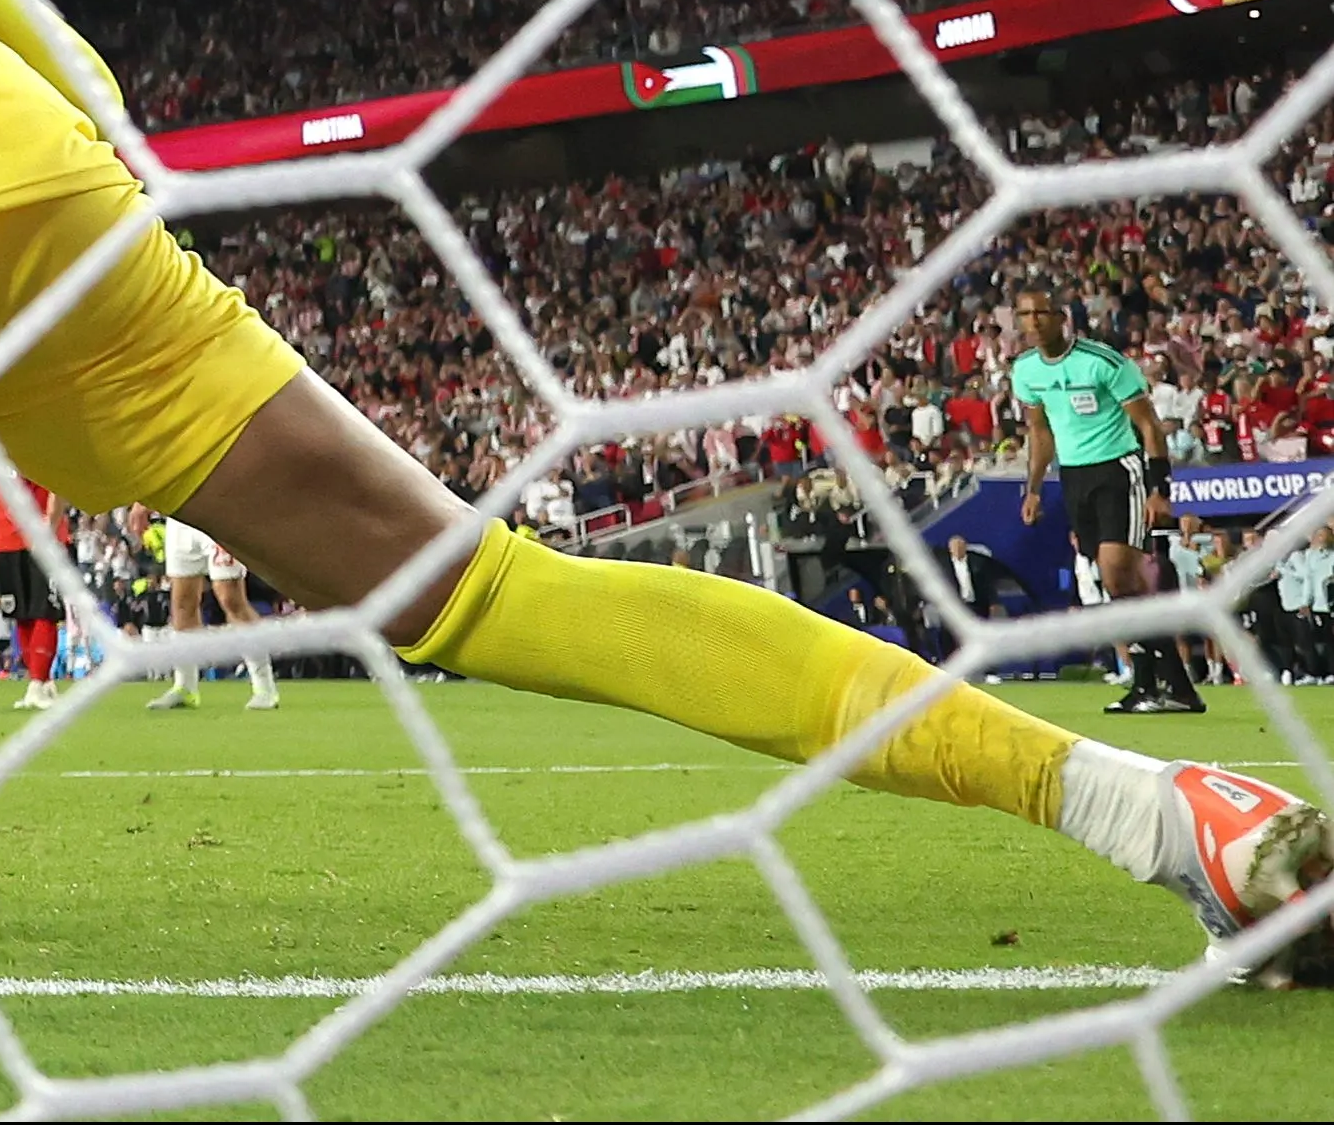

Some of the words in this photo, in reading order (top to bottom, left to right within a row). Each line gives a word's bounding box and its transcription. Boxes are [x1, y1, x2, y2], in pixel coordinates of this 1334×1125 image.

[935, 11, 996, 49] JORDAN
[302, 113, 364, 146] AUSTRIA
[1169, 480, 1194, 503] FA
[1190, 475, 1264, 502] WORLD
[1264, 473, 1305, 498] CUP
